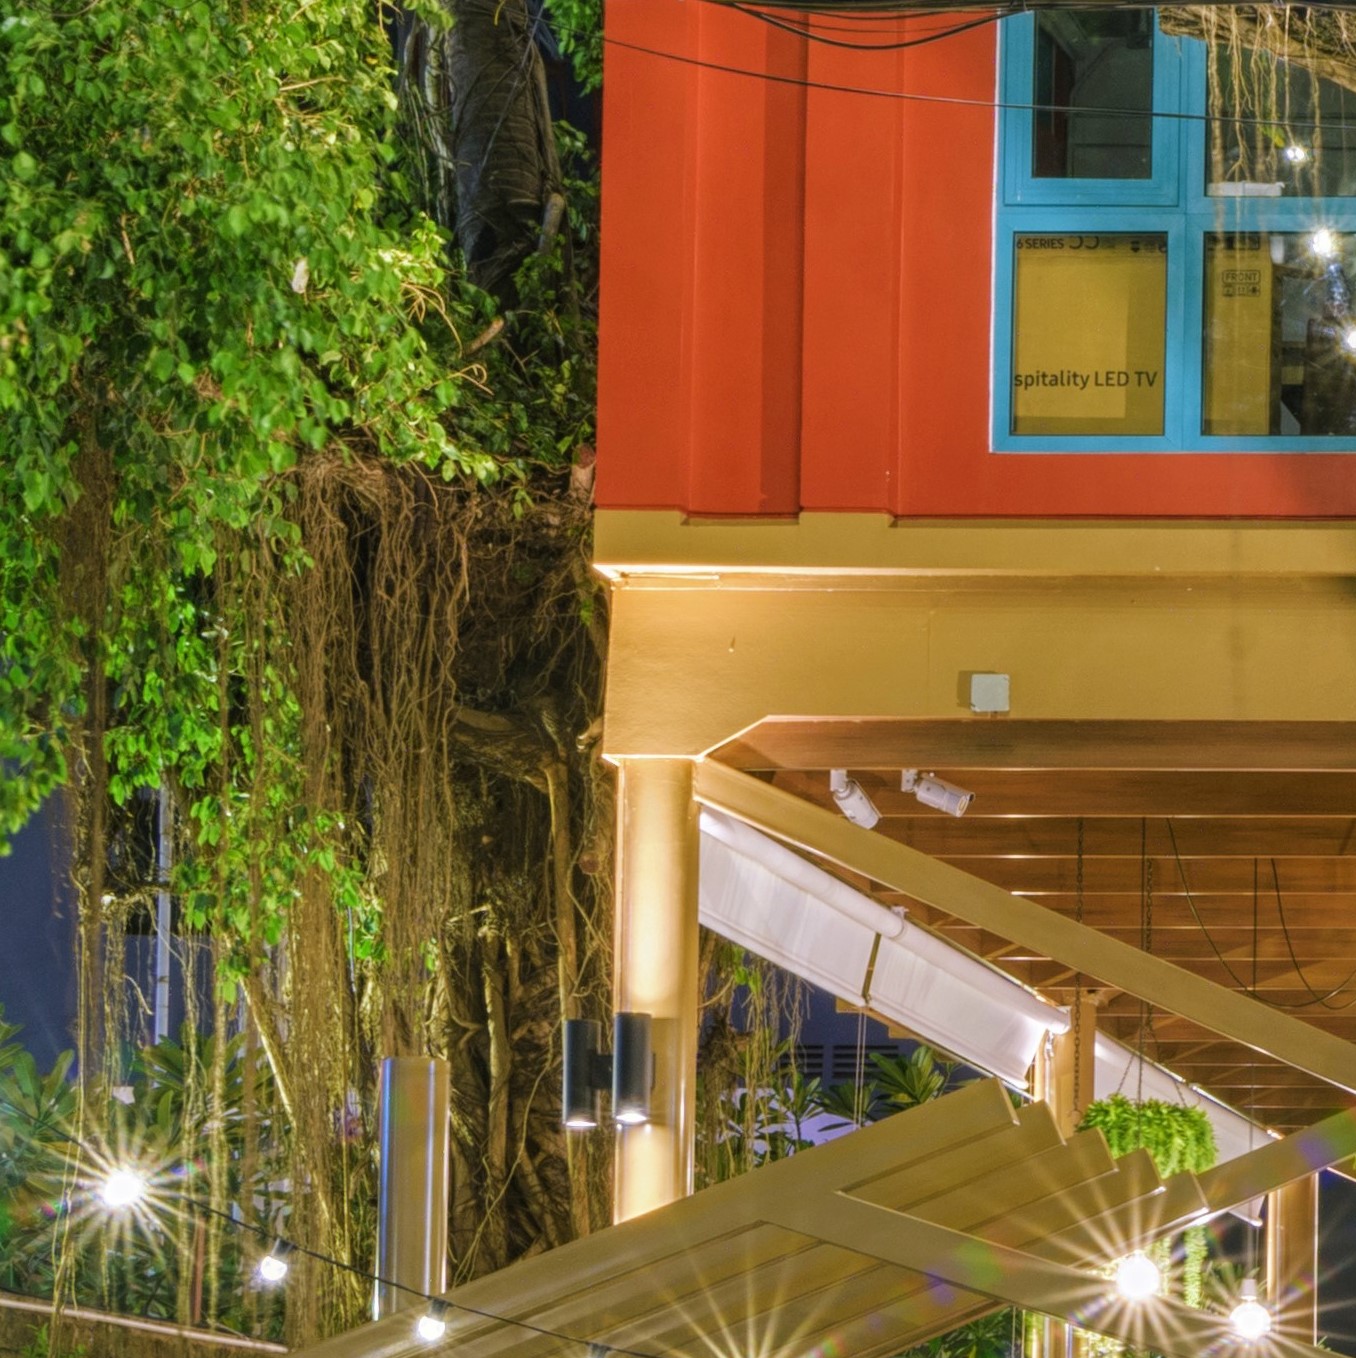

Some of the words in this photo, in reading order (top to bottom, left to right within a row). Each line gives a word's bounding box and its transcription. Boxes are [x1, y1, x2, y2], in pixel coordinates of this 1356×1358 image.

[1025, 237, 1065, 249] SERIES
[1225, 272, 1258, 281] FRONT
[1014, 370, 1090, 390] spitality
[1094, 371, 1129, 387] LED
[1134, 371, 1158, 387] TV
